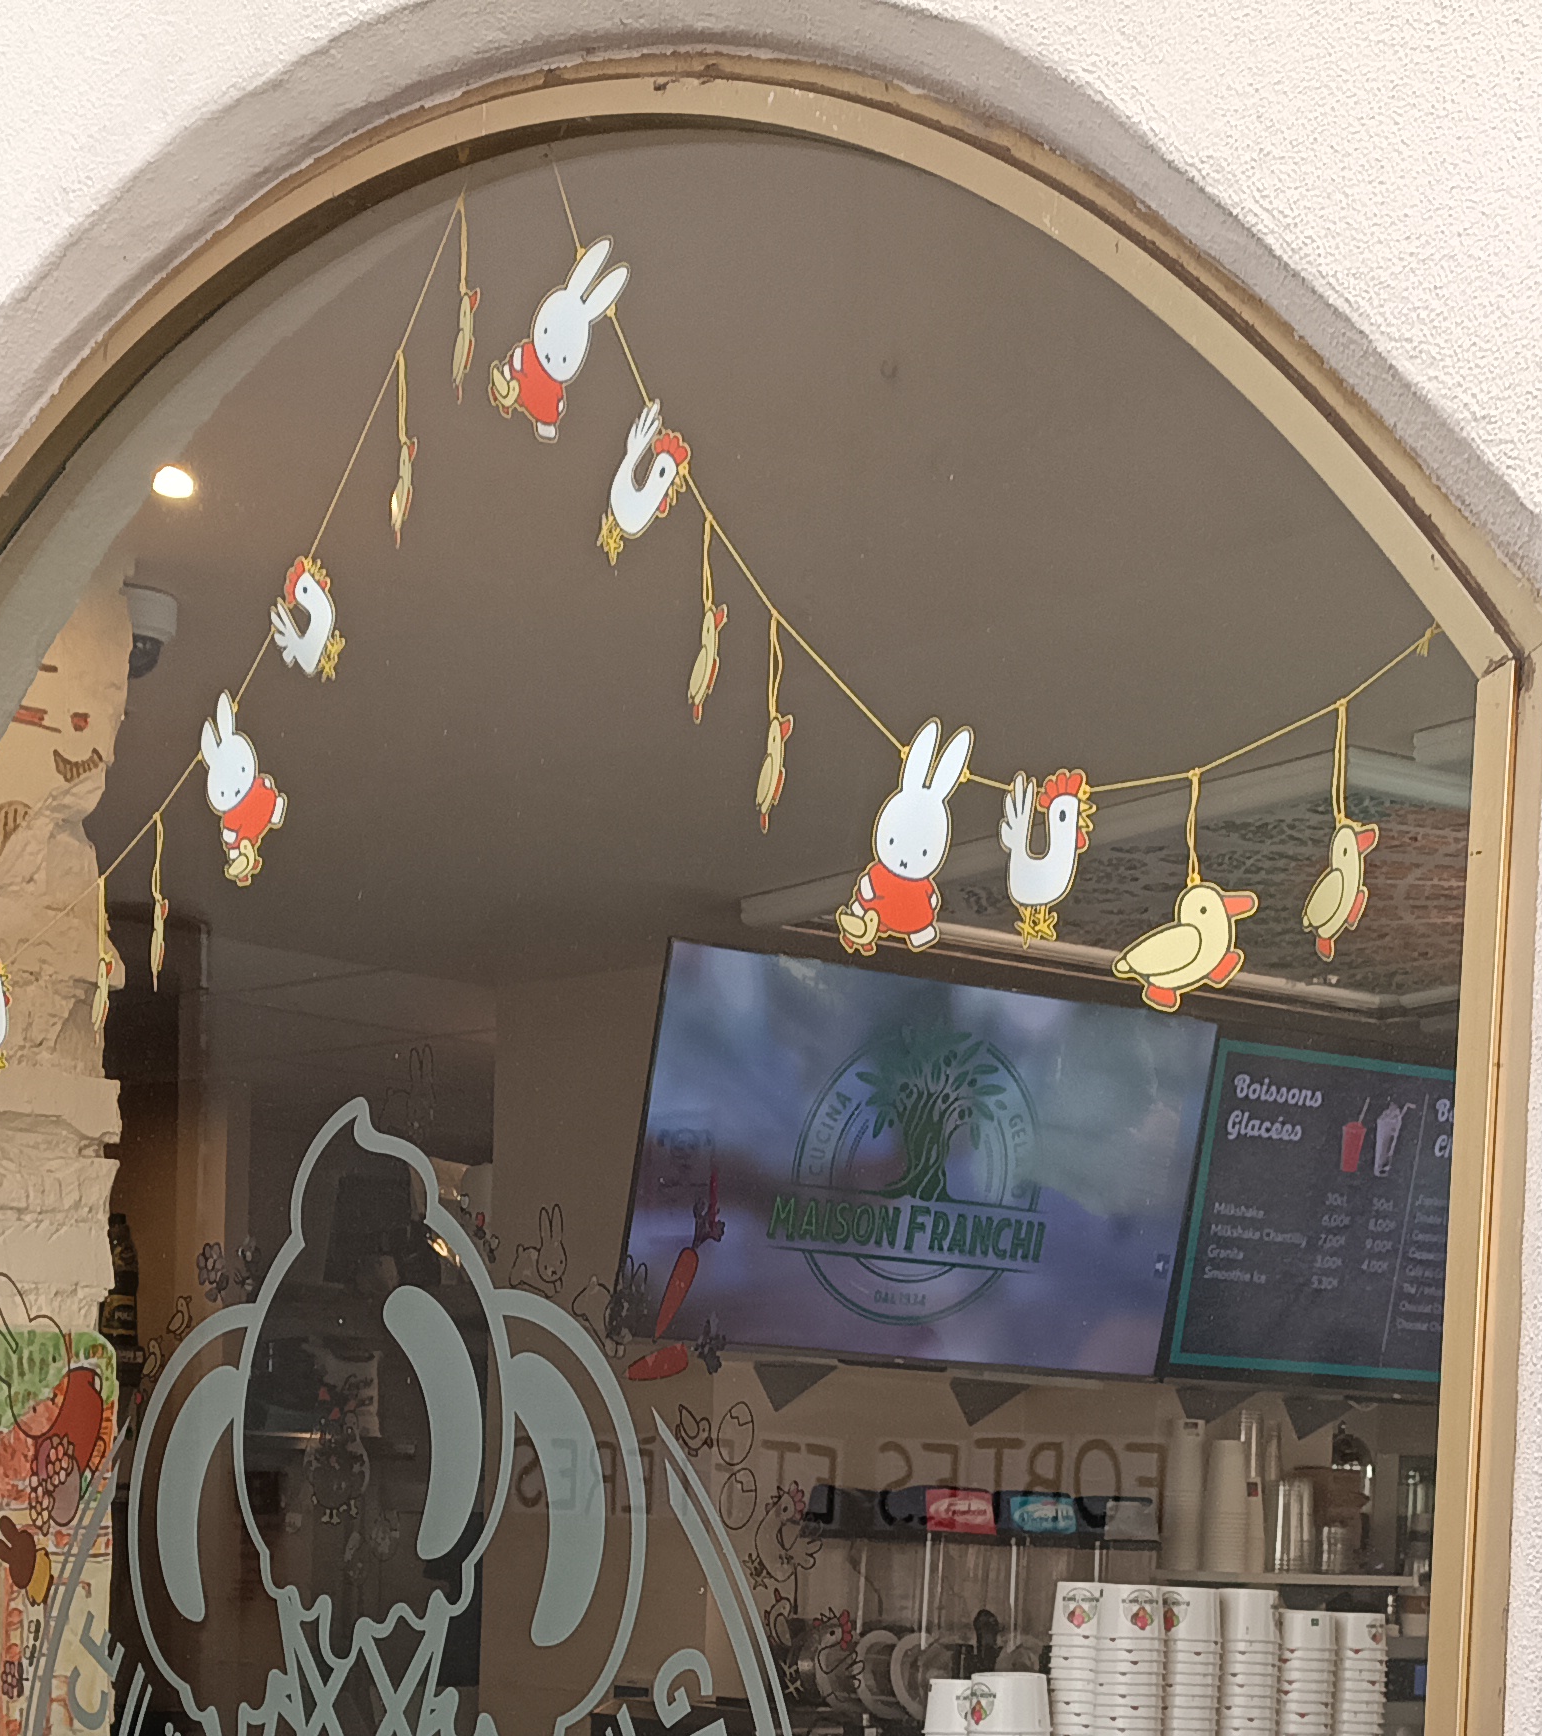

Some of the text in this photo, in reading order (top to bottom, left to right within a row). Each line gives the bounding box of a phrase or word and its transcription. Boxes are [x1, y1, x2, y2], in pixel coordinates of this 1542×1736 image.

[1235, 1074, 1322, 1107] Boissons
[1228, 1110, 1301, 1141] Glacées
[766, 1193, 1046, 1264] MAISON FRANCHI
